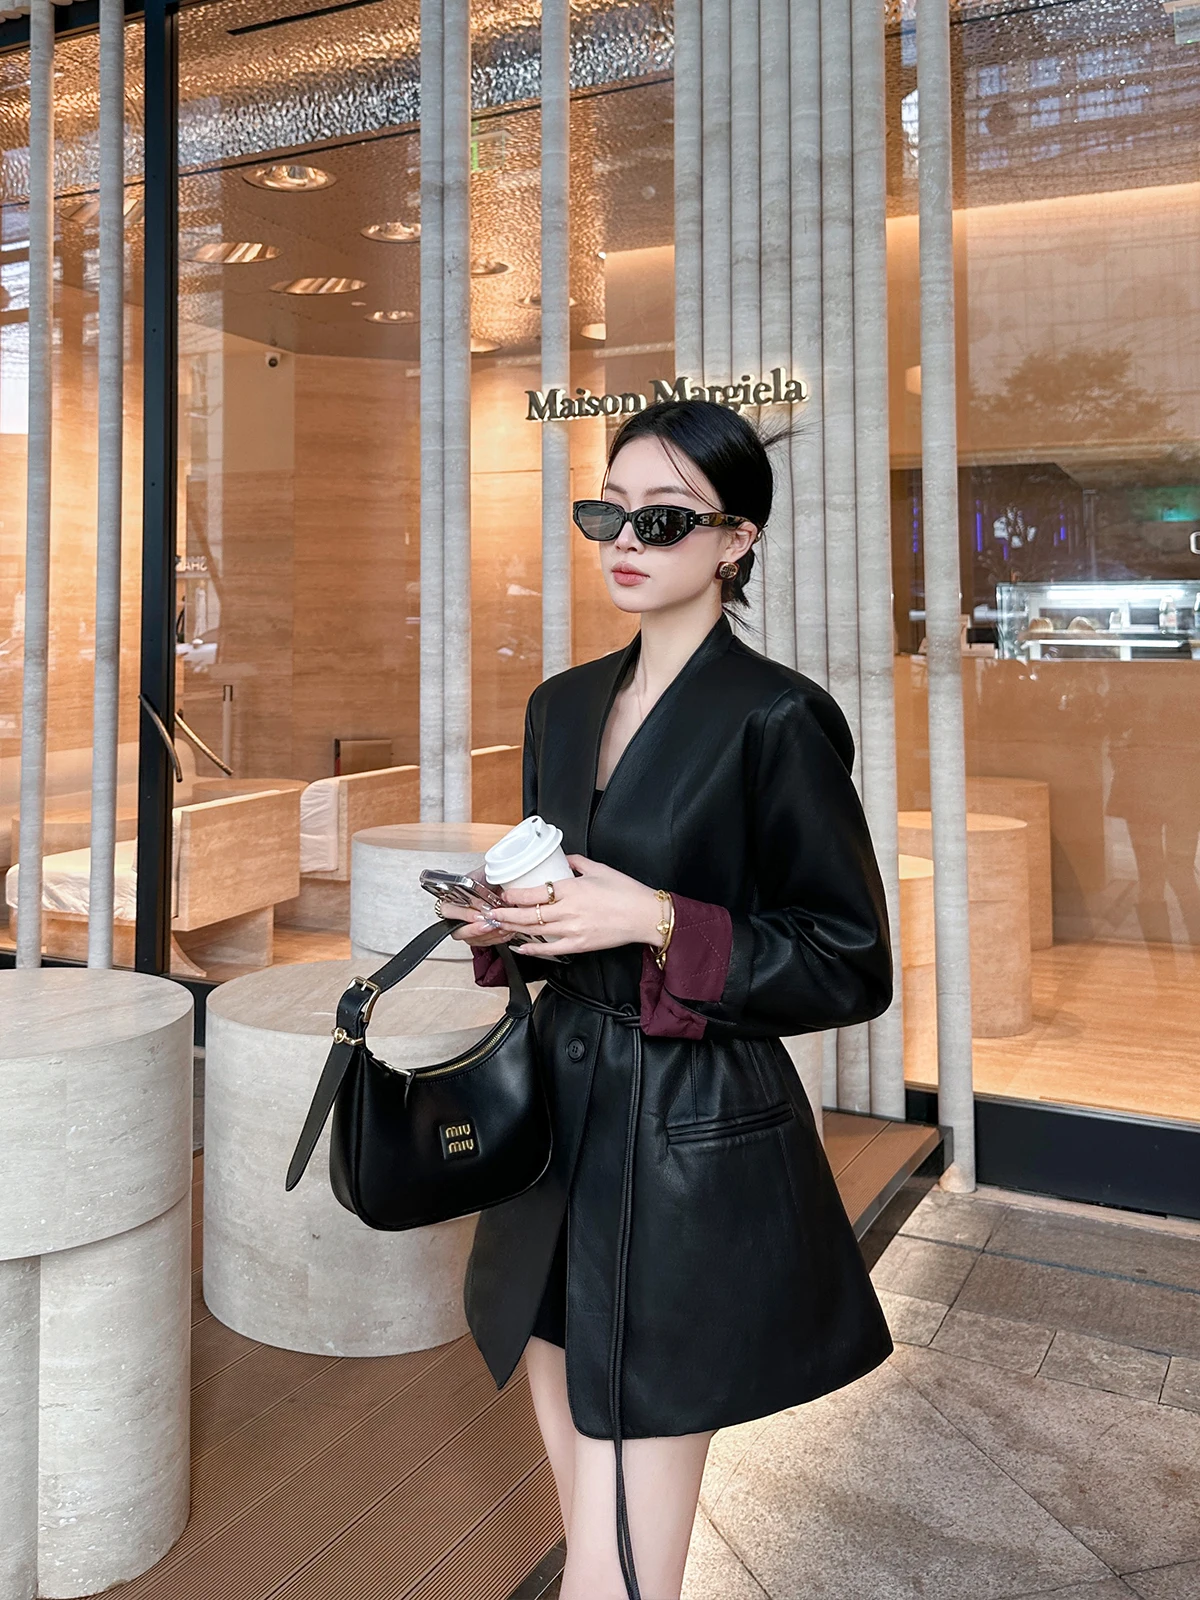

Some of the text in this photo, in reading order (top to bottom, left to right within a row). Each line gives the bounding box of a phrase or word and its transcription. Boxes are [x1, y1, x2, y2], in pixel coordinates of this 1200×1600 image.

[524, 367, 808, 421] Maison Margiela
[445, 1123, 471, 1139] miu
[448, 1138, 474, 1154] miu
